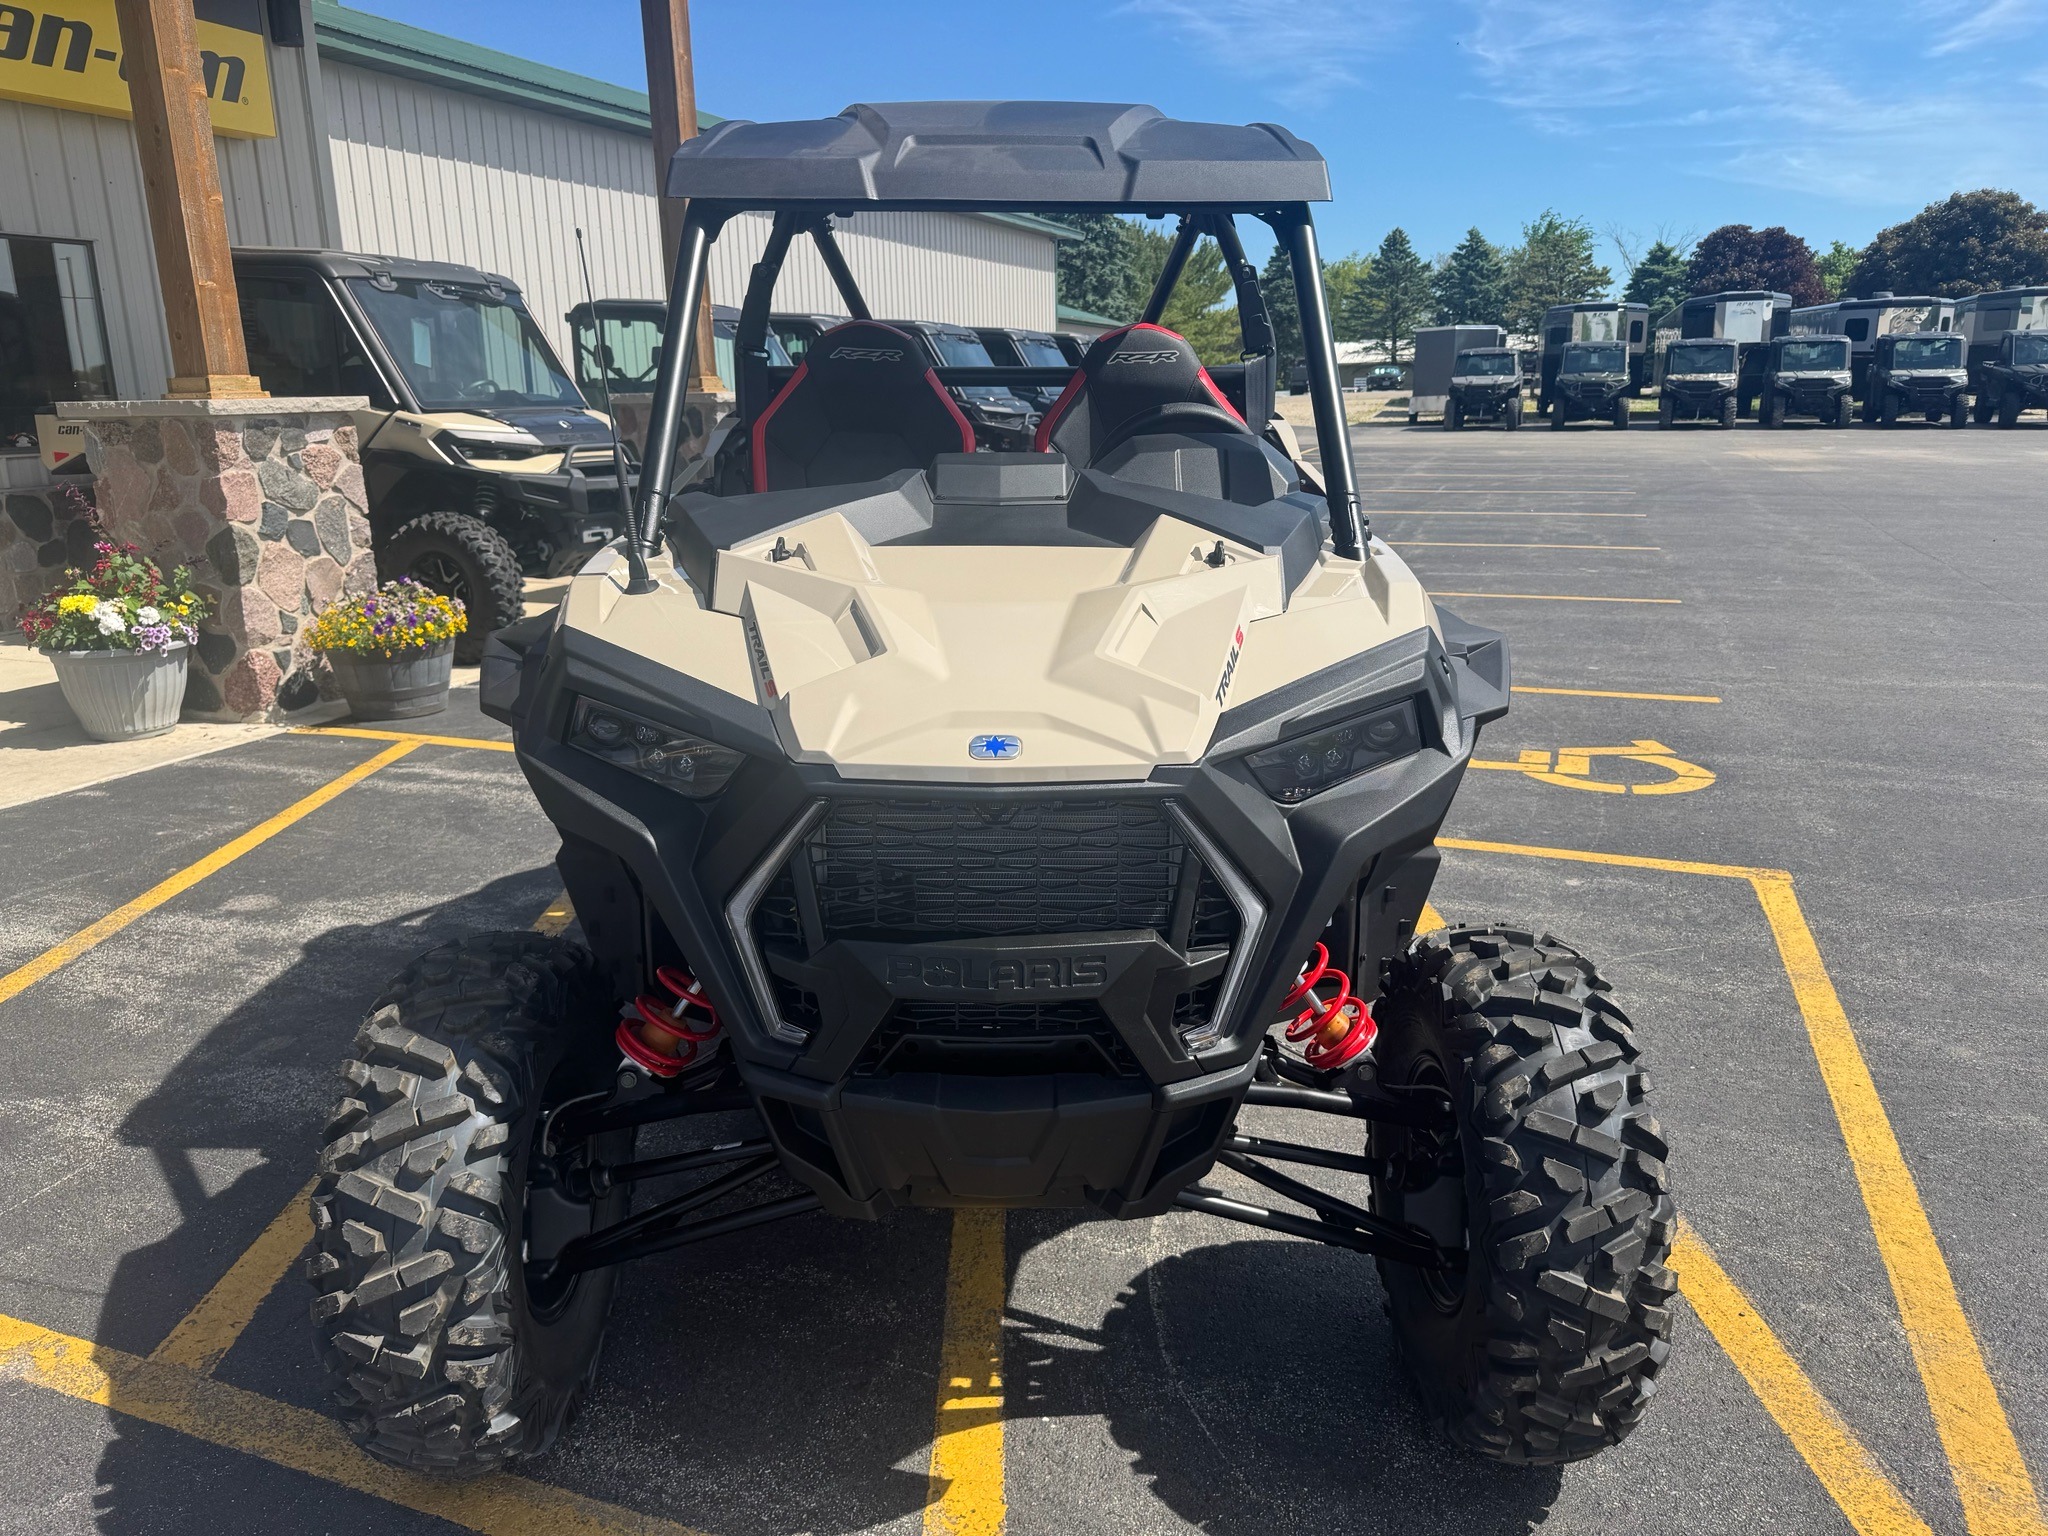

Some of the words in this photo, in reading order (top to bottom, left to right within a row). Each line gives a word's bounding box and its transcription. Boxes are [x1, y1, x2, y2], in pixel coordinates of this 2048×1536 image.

[829, 346, 904, 362] RZR
[1107, 350, 1180, 365] RZR
[748, 621, 770, 680] TRAIL
[764, 679, 778, 698] S
[1215, 645, 1239, 708] TRAIL
[886, 954, 1108, 990] POLARIS
